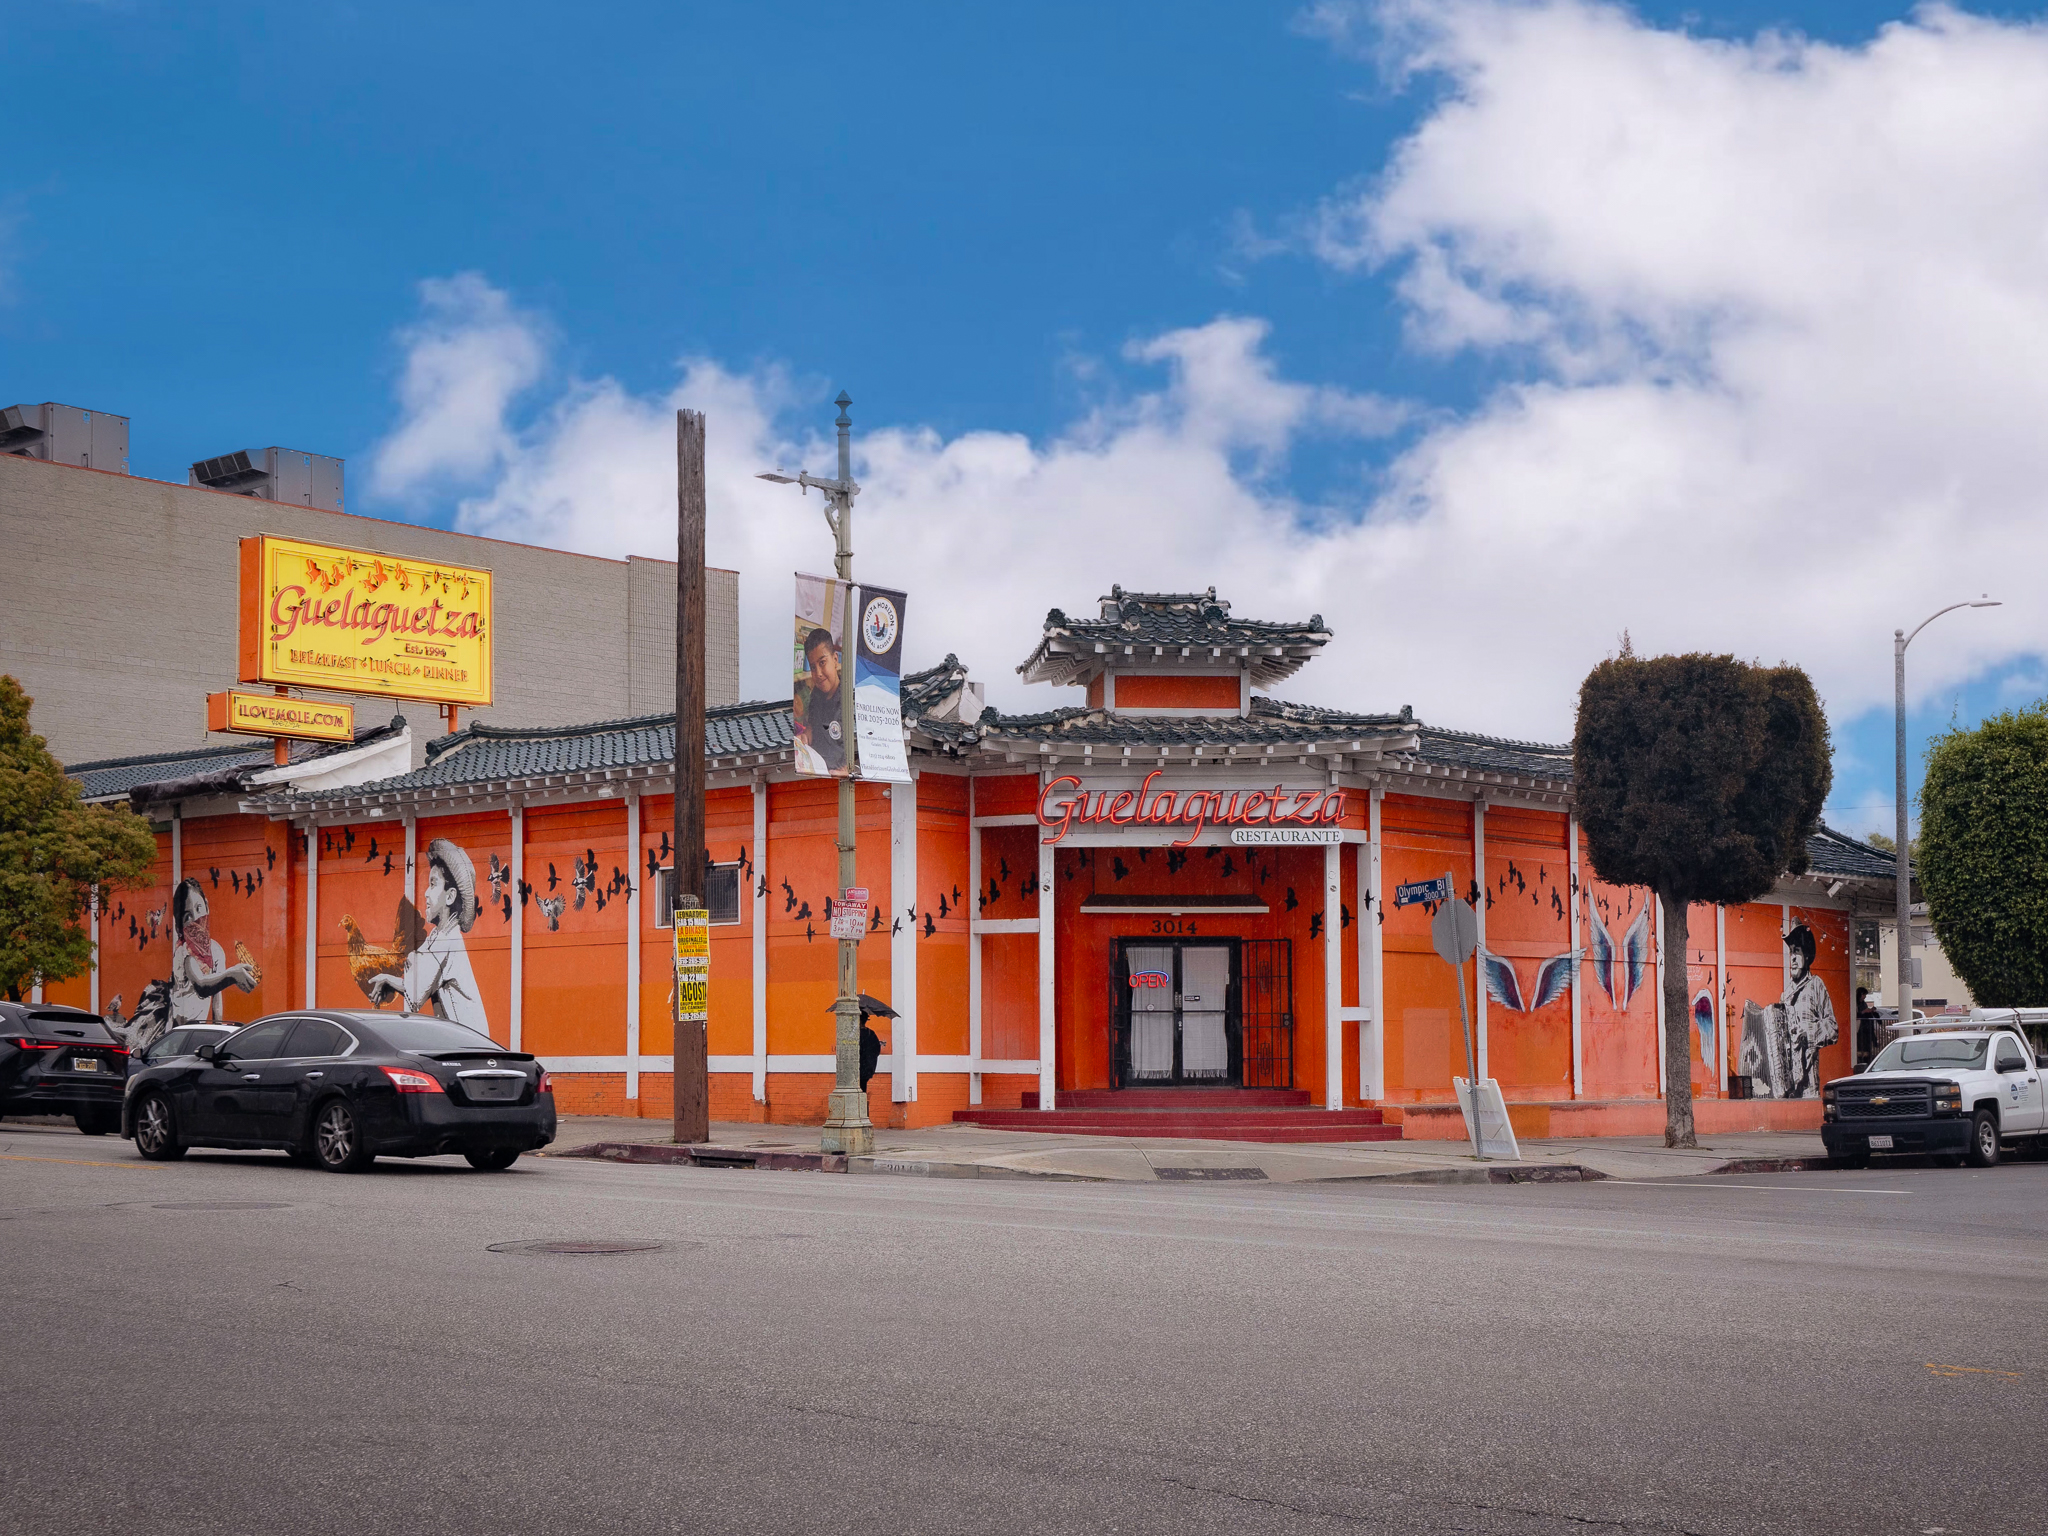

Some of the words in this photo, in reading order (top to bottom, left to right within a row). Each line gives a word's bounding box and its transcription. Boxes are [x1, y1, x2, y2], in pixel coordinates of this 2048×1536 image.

[270, 584, 485, 645] Guelaguetza
[866, 605, 877, 622] VISTA
[877, 602, 895, 626] HORIZON
[424, 645, 447, 658] 1994
[290, 649, 358, 670] BREAKFAST
[370, 657, 411, 676] LUNCH
[424, 665, 469, 683] DINNER
[239, 704, 345, 728] ILOVEMOLE.COM
[856, 702, 886, 714] ENROLLING
[886, 708, 900, 716] NOW
[857, 713, 868, 722] FOR
[869, 714, 900, 726] 2025-2026
[1036, 770, 1350, 847] Guelaguetza
[1235, 830, 1341, 843] RESTAURANTE
[1398, 884, 1429, 897] Olympic
[1424, 891, 1438, 899] 3000
[843, 909, 865, 917] STOPPING
[1152, 919, 1198, 935] 3014
[1128, 974, 1167, 988] OPEN
